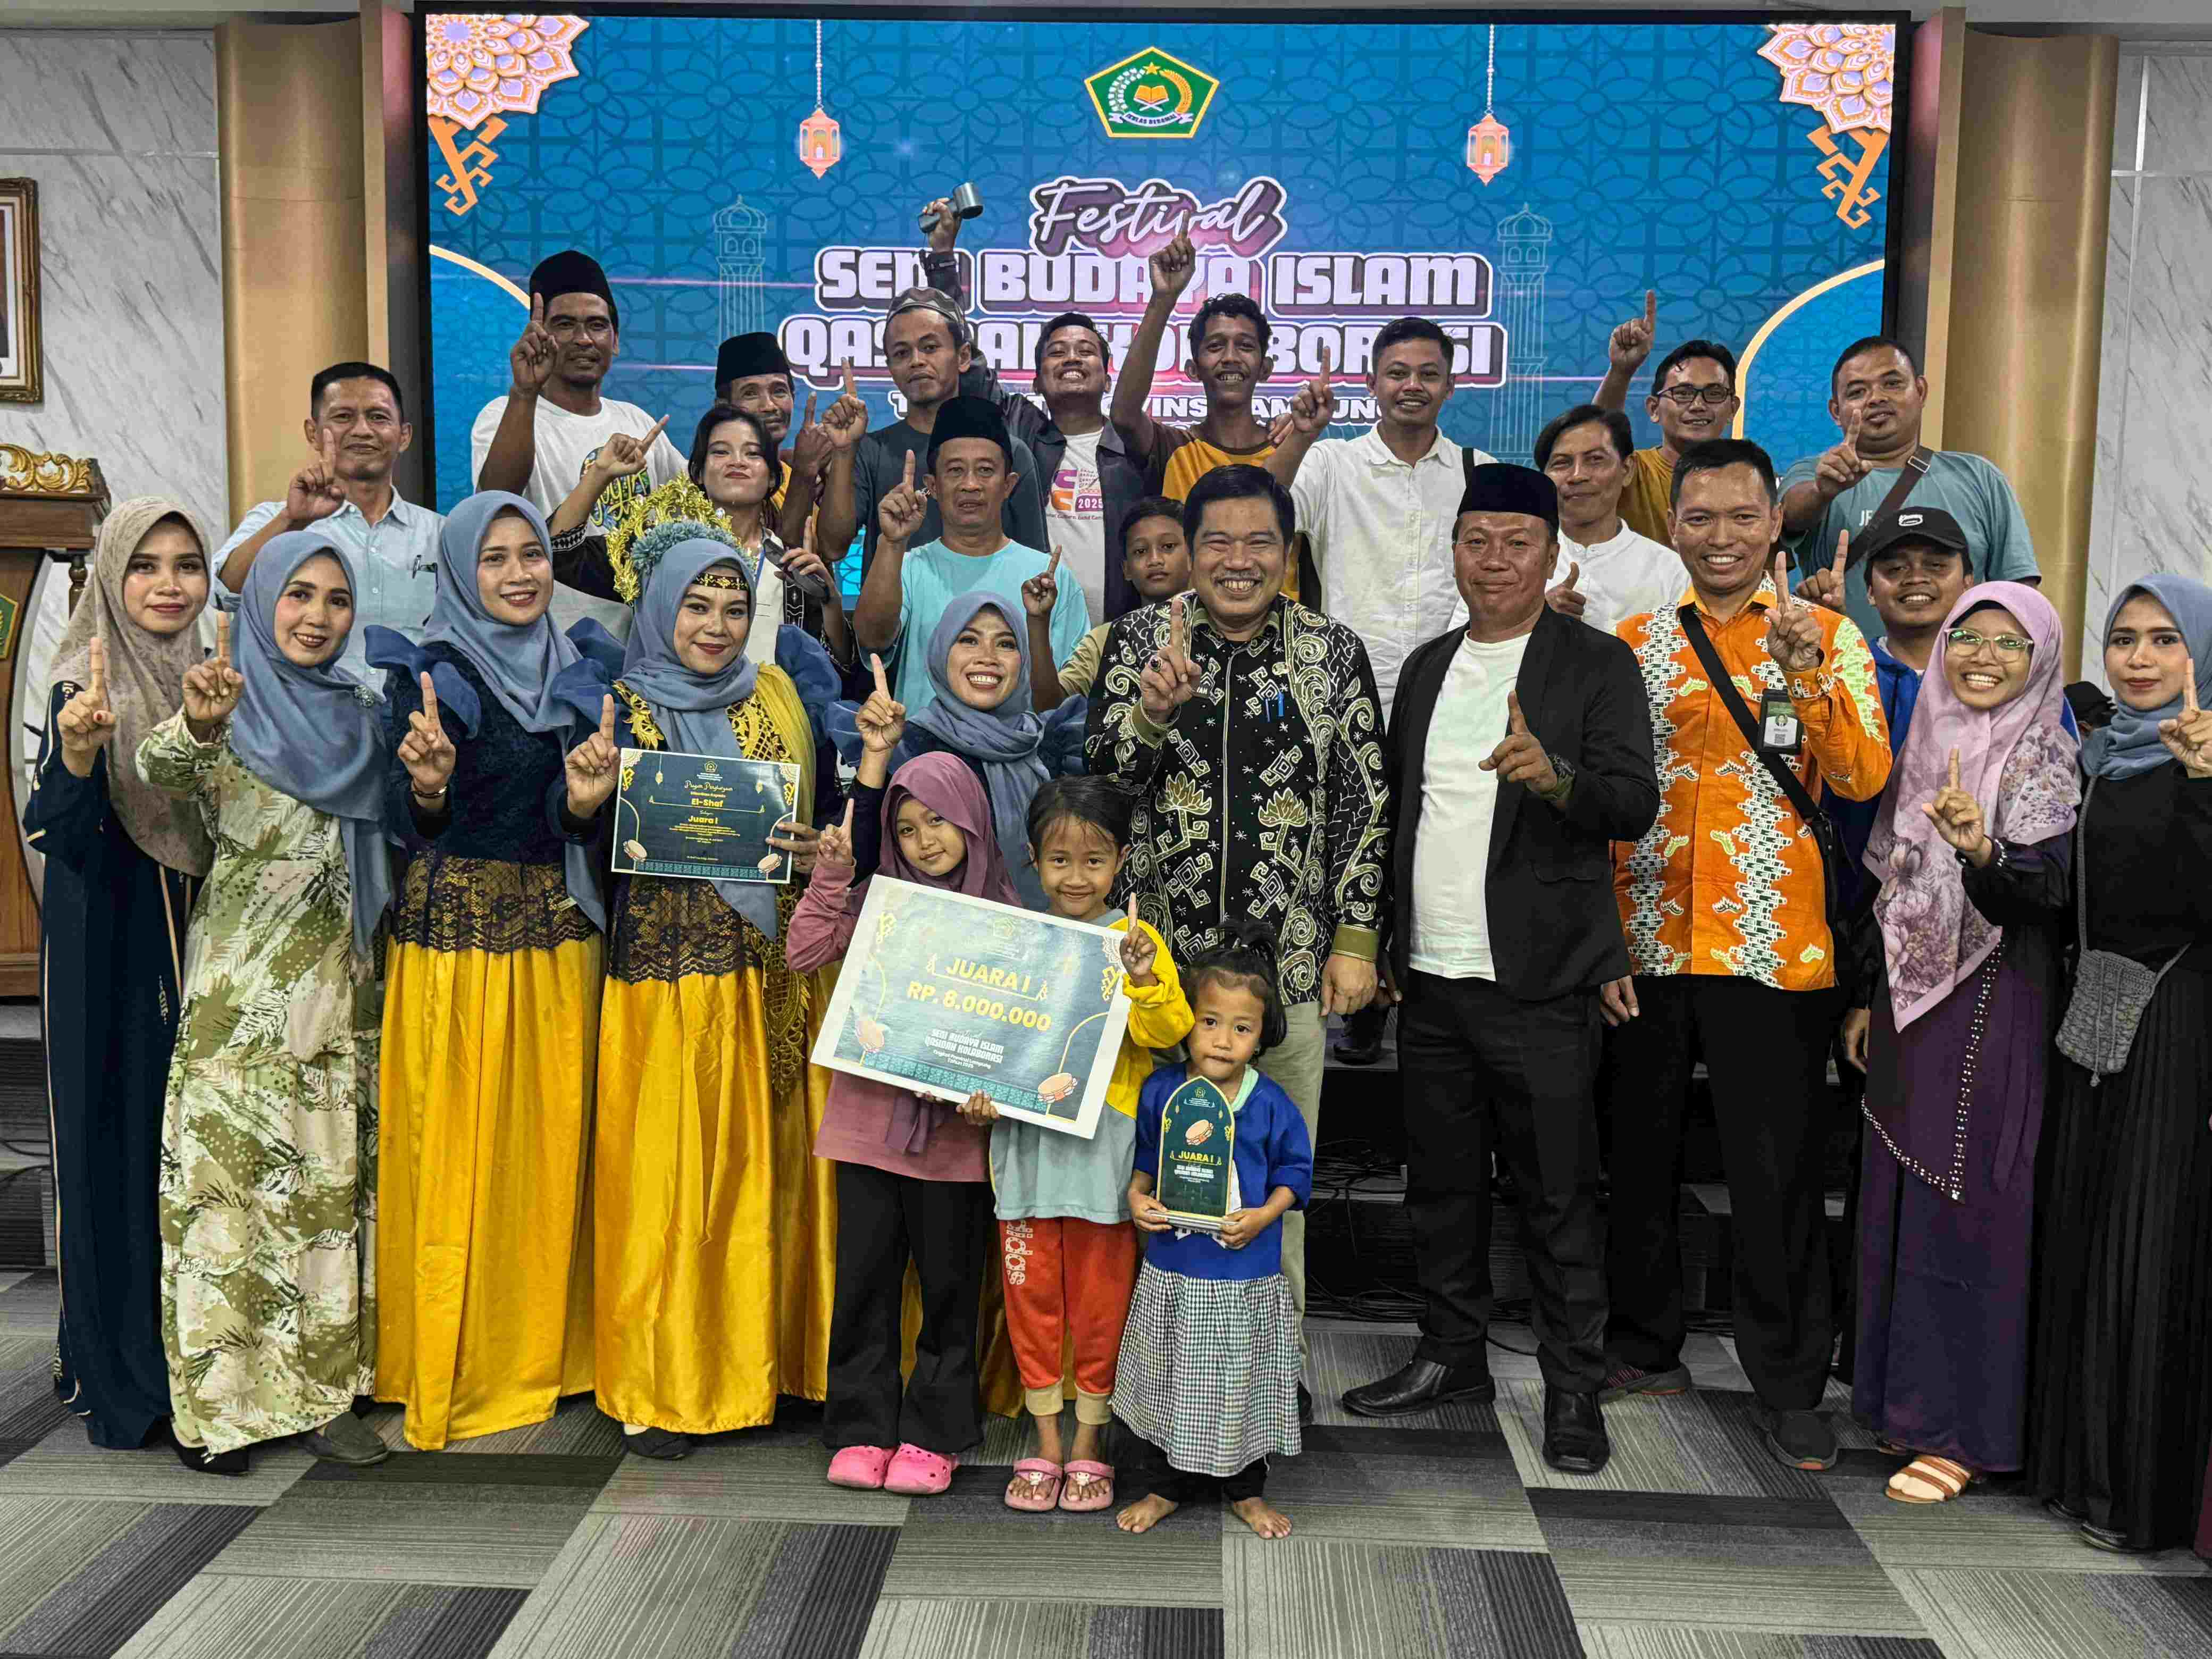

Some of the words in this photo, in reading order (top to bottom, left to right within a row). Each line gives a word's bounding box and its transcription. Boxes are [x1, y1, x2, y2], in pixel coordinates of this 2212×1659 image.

[822, 250, 958, 299] SEN
[1275, 256, 1477, 305] ISLAM
[1078, 498, 1103, 509] 2025
[688, 815, 714, 824] Juara
[945, 958, 1018, 988] JUARA
[1178, 1150, 1209, 1162] JUARA
